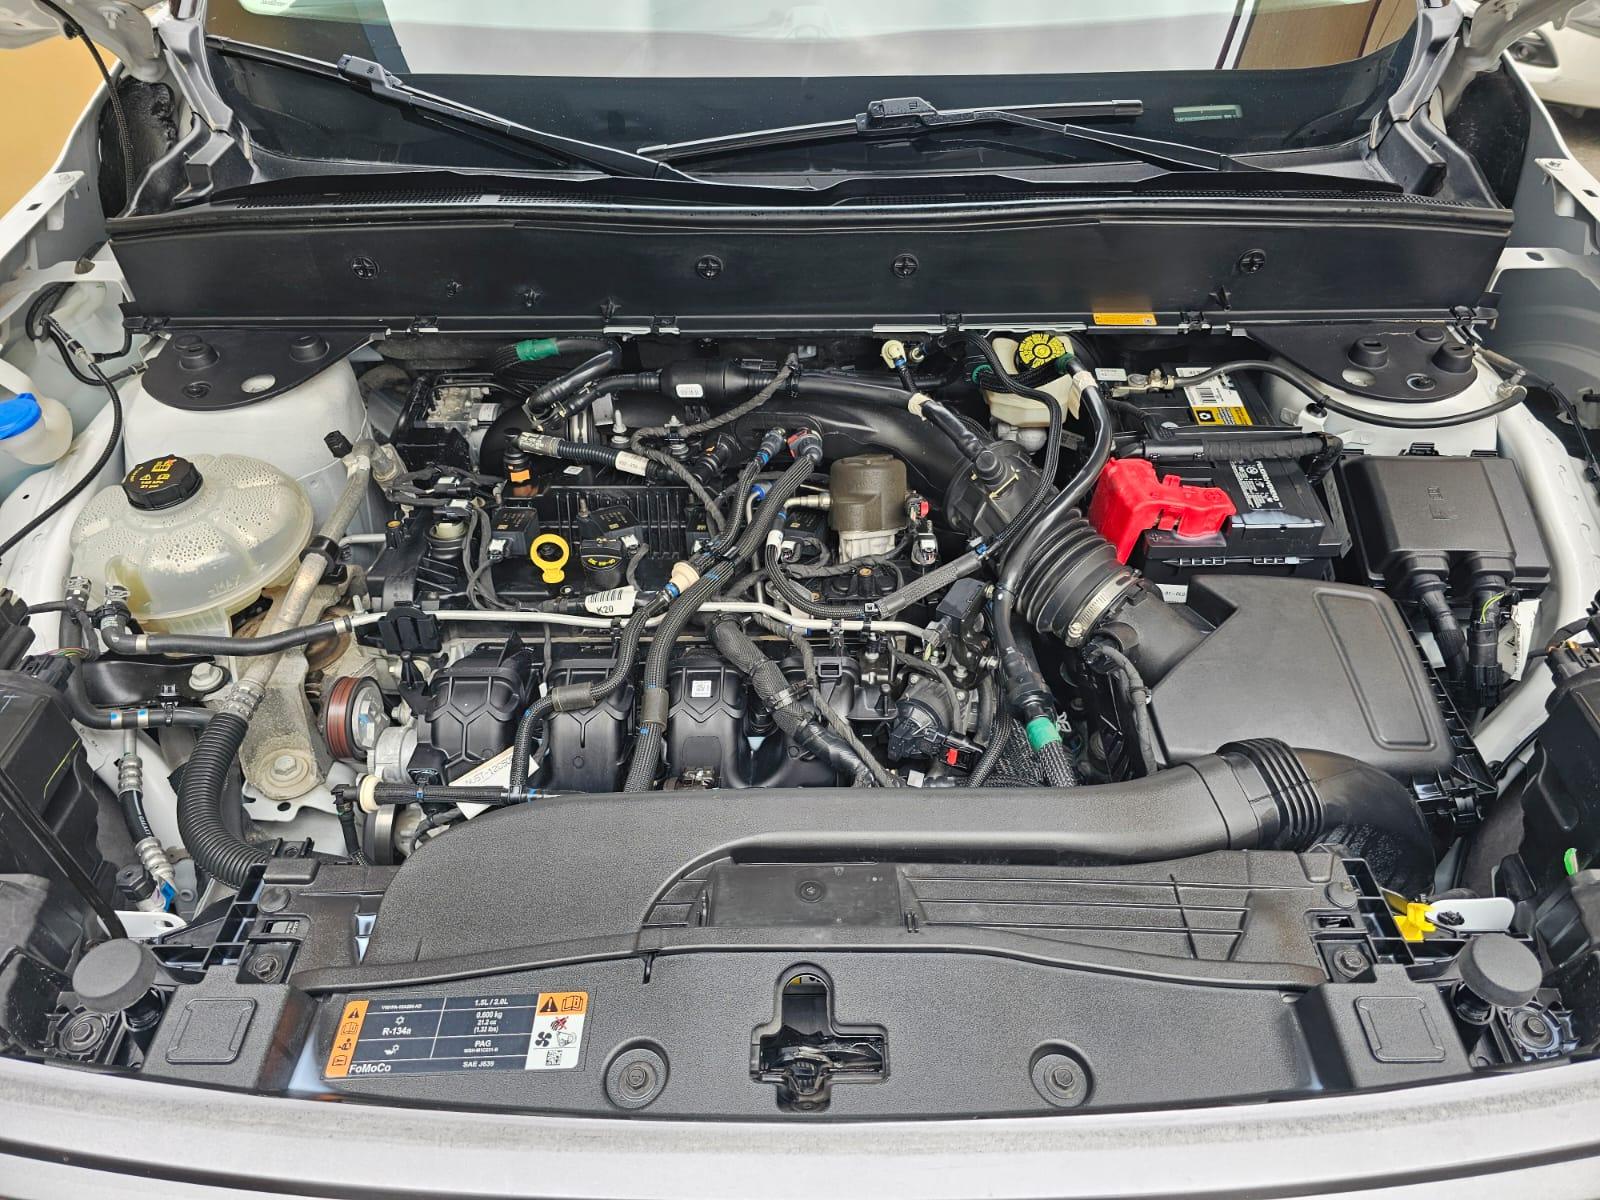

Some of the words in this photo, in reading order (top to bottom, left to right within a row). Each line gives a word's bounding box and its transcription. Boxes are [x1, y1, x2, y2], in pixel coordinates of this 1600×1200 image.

[382, 1026, 412, 1036] R-134a
[474, 1039, 492, 1048] PAG
[349, 1063, 392, 1074] FoMoCo
